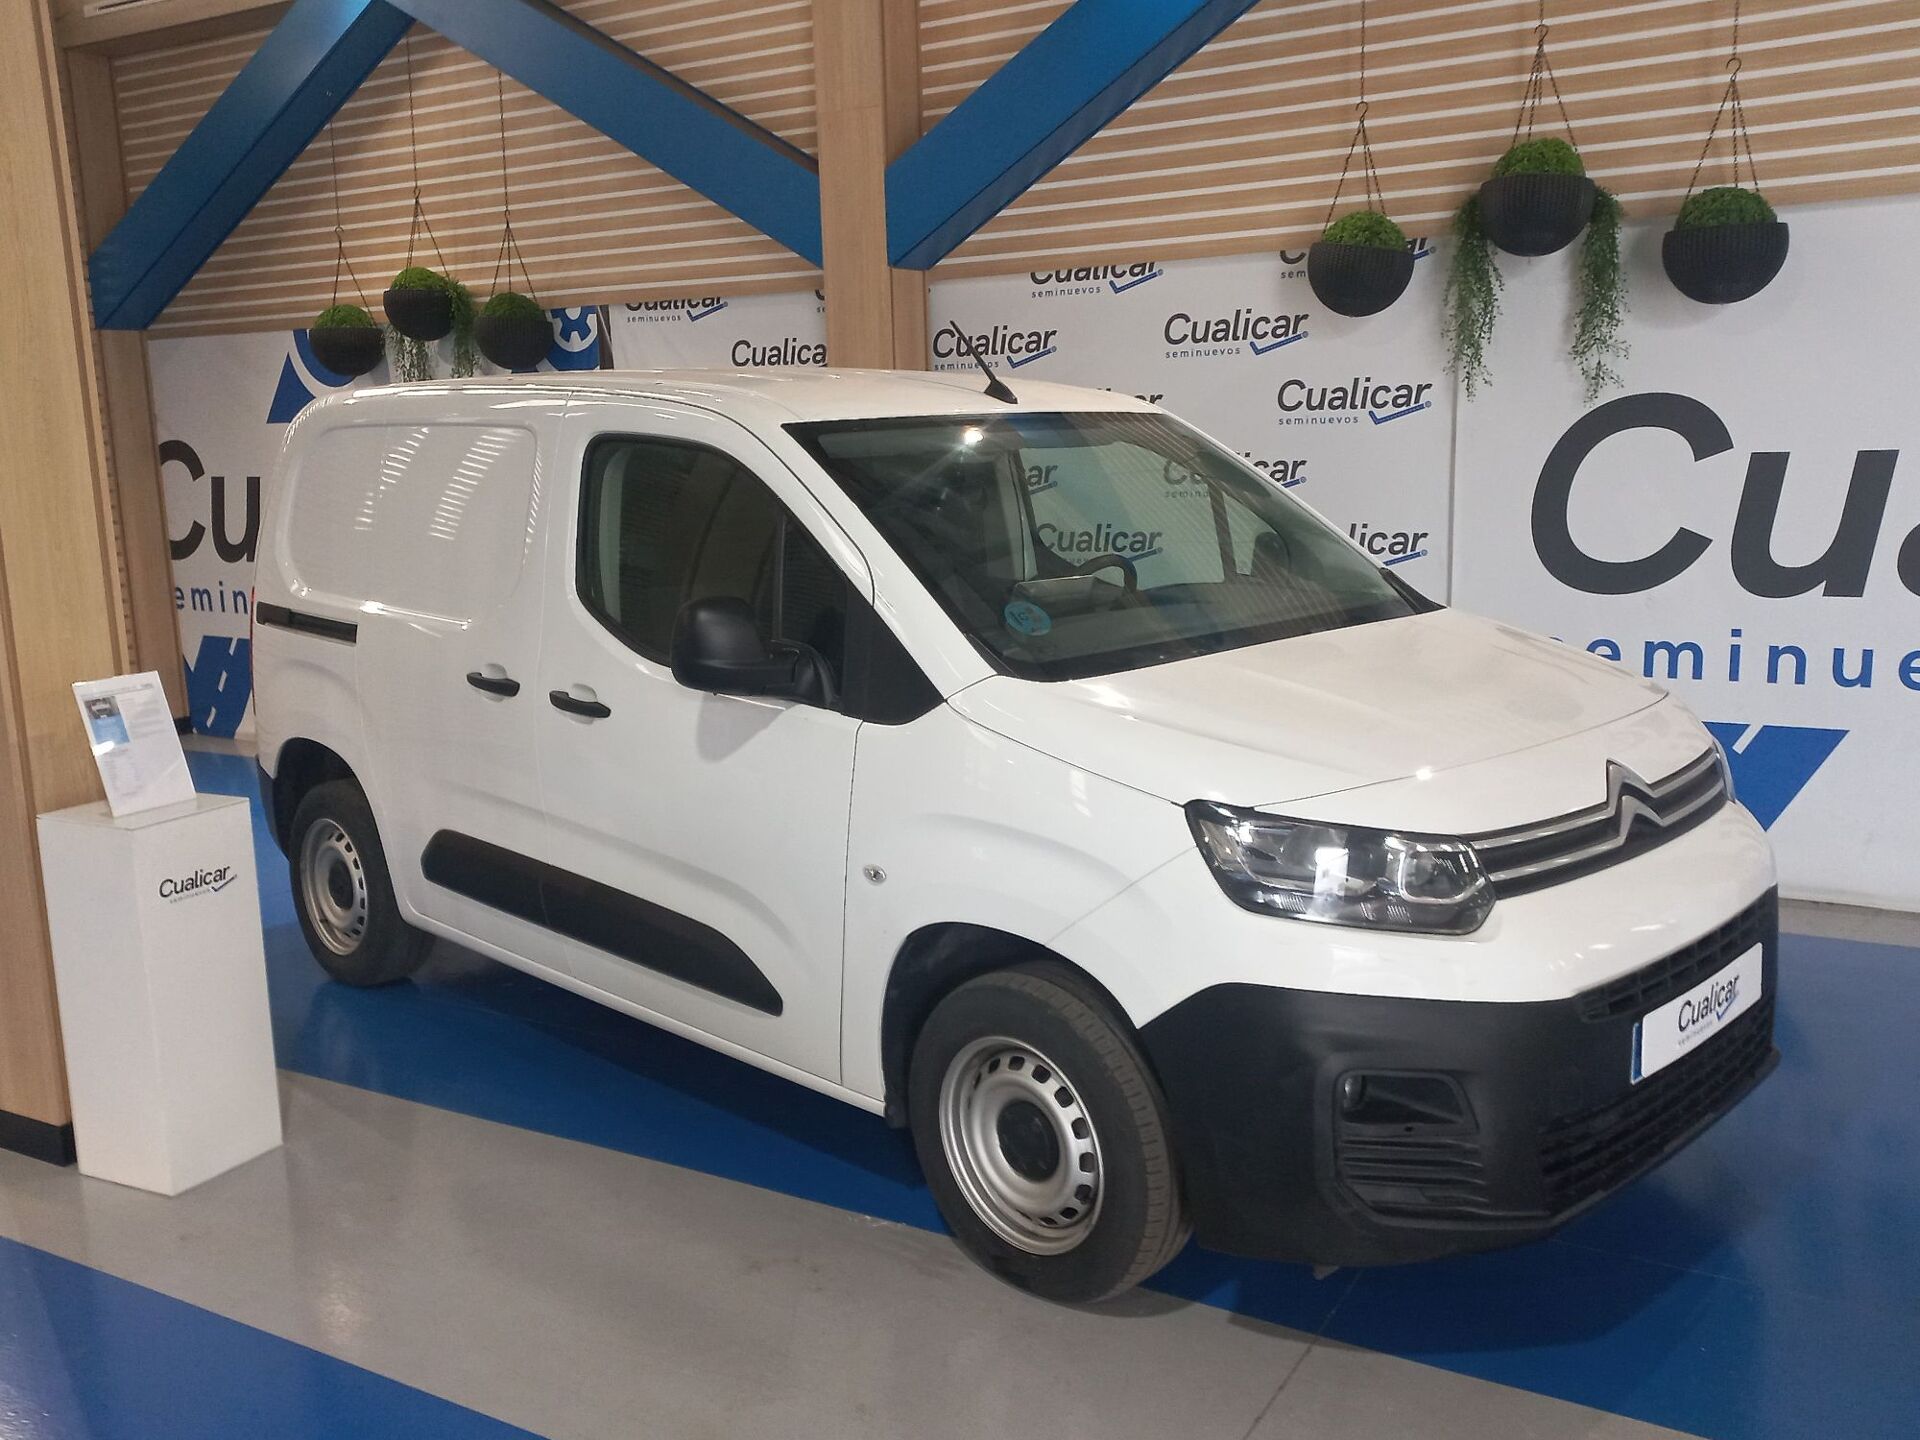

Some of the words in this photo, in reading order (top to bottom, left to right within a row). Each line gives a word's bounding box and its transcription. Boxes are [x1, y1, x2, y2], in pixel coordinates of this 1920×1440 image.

[1031, 286, 1102, 299] seminuevos
[626, 315, 682, 324] seminuevos
[1164, 308, 1310, 346] Cualicar
[731, 337, 827, 368] Cualica
[932, 325, 1058, 359] Cualicar
[1165, 347, 1241, 359] seminuevos
[934, 360, 1000, 372] seminueos
[1277, 377, 1433, 412] Cualicar
[1278, 416, 1359, 426] seminuevos
[1037, 523, 1163, 553] Cualicar
[175, 580, 249, 614] emin
[1548, 628, 1920, 691] eminue
[159, 866, 231, 898] Cualicar
[1678, 975, 1740, 1032] Cualicar
